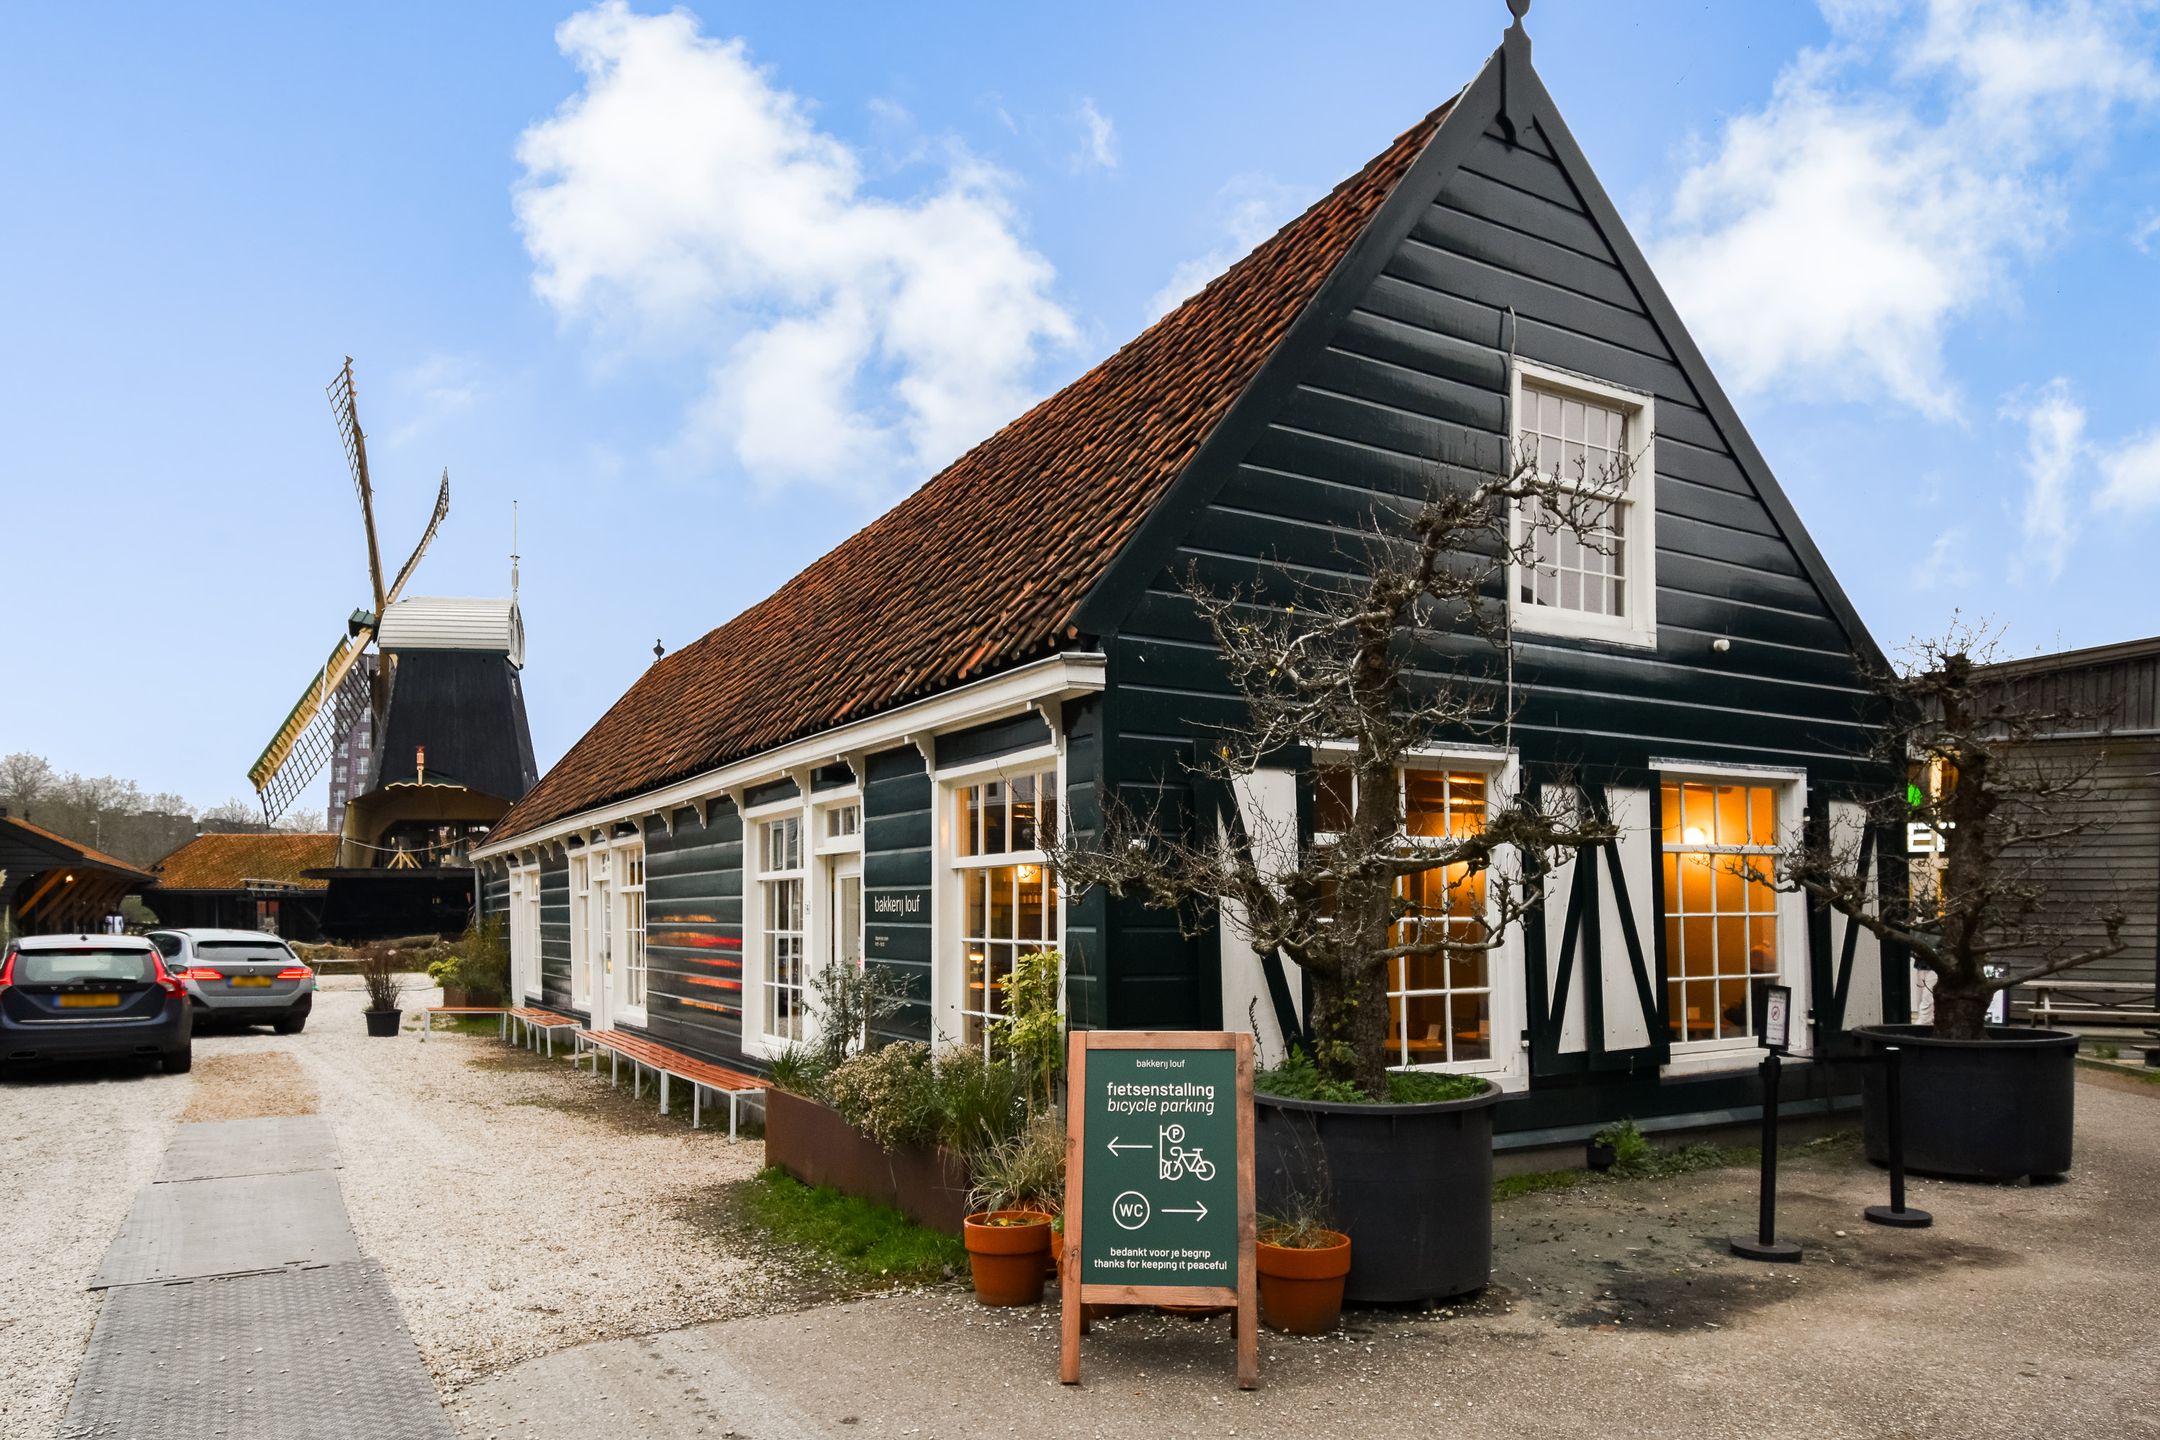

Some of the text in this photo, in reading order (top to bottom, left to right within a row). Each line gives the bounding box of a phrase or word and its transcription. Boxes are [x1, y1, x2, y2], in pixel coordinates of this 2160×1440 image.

[874, 895, 921, 917] bakkerij louf
[1136, 1059, 1186, 1070] bakkerij louf
[1107, 1082, 1215, 1100] fietsenstalling
[1107, 1098, 1215, 1115] bicycle parking
[1172, 1128, 1180, 1139] P
[1119, 1203, 1144, 1217] WC
[1110, 1247, 1211, 1260] bedankt voor je begrip
[1094, 1258, 1228, 1271] thanks for keeping it peaceful
